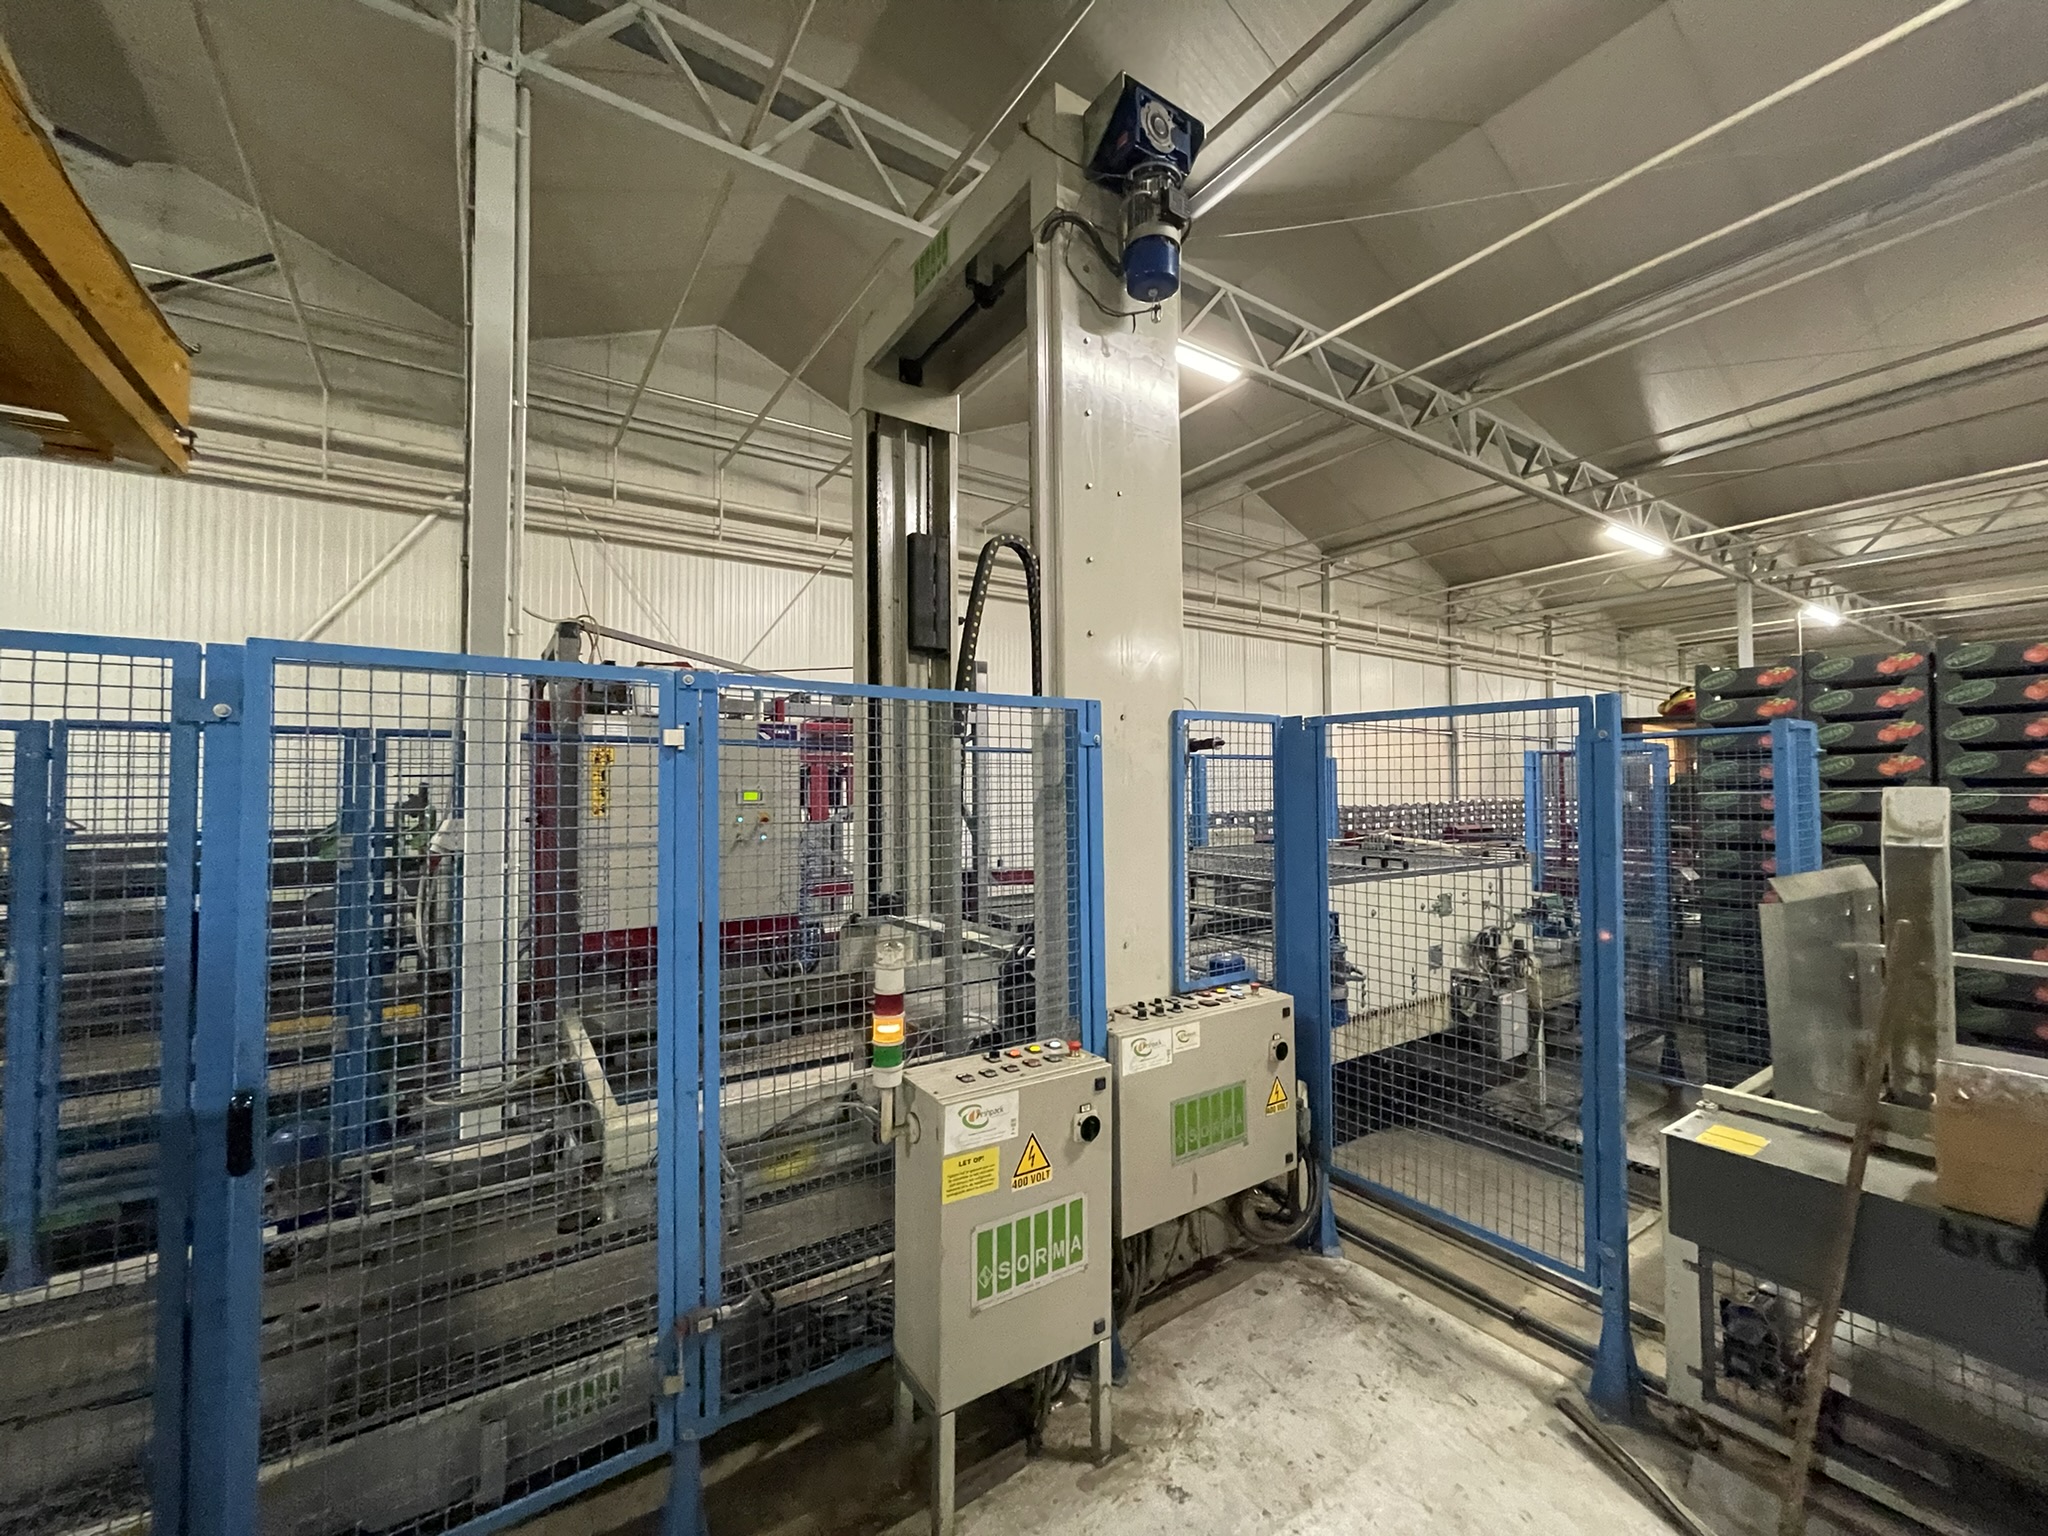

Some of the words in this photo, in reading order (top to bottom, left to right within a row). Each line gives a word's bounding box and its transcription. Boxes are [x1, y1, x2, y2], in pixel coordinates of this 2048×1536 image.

[958, 1159, 971, 1167] LET
[1012, 1176, 1029, 1189] 400
[1030, 1170, 1050, 1184] VOLT
[998, 1234, 1082, 1280] SORMA
